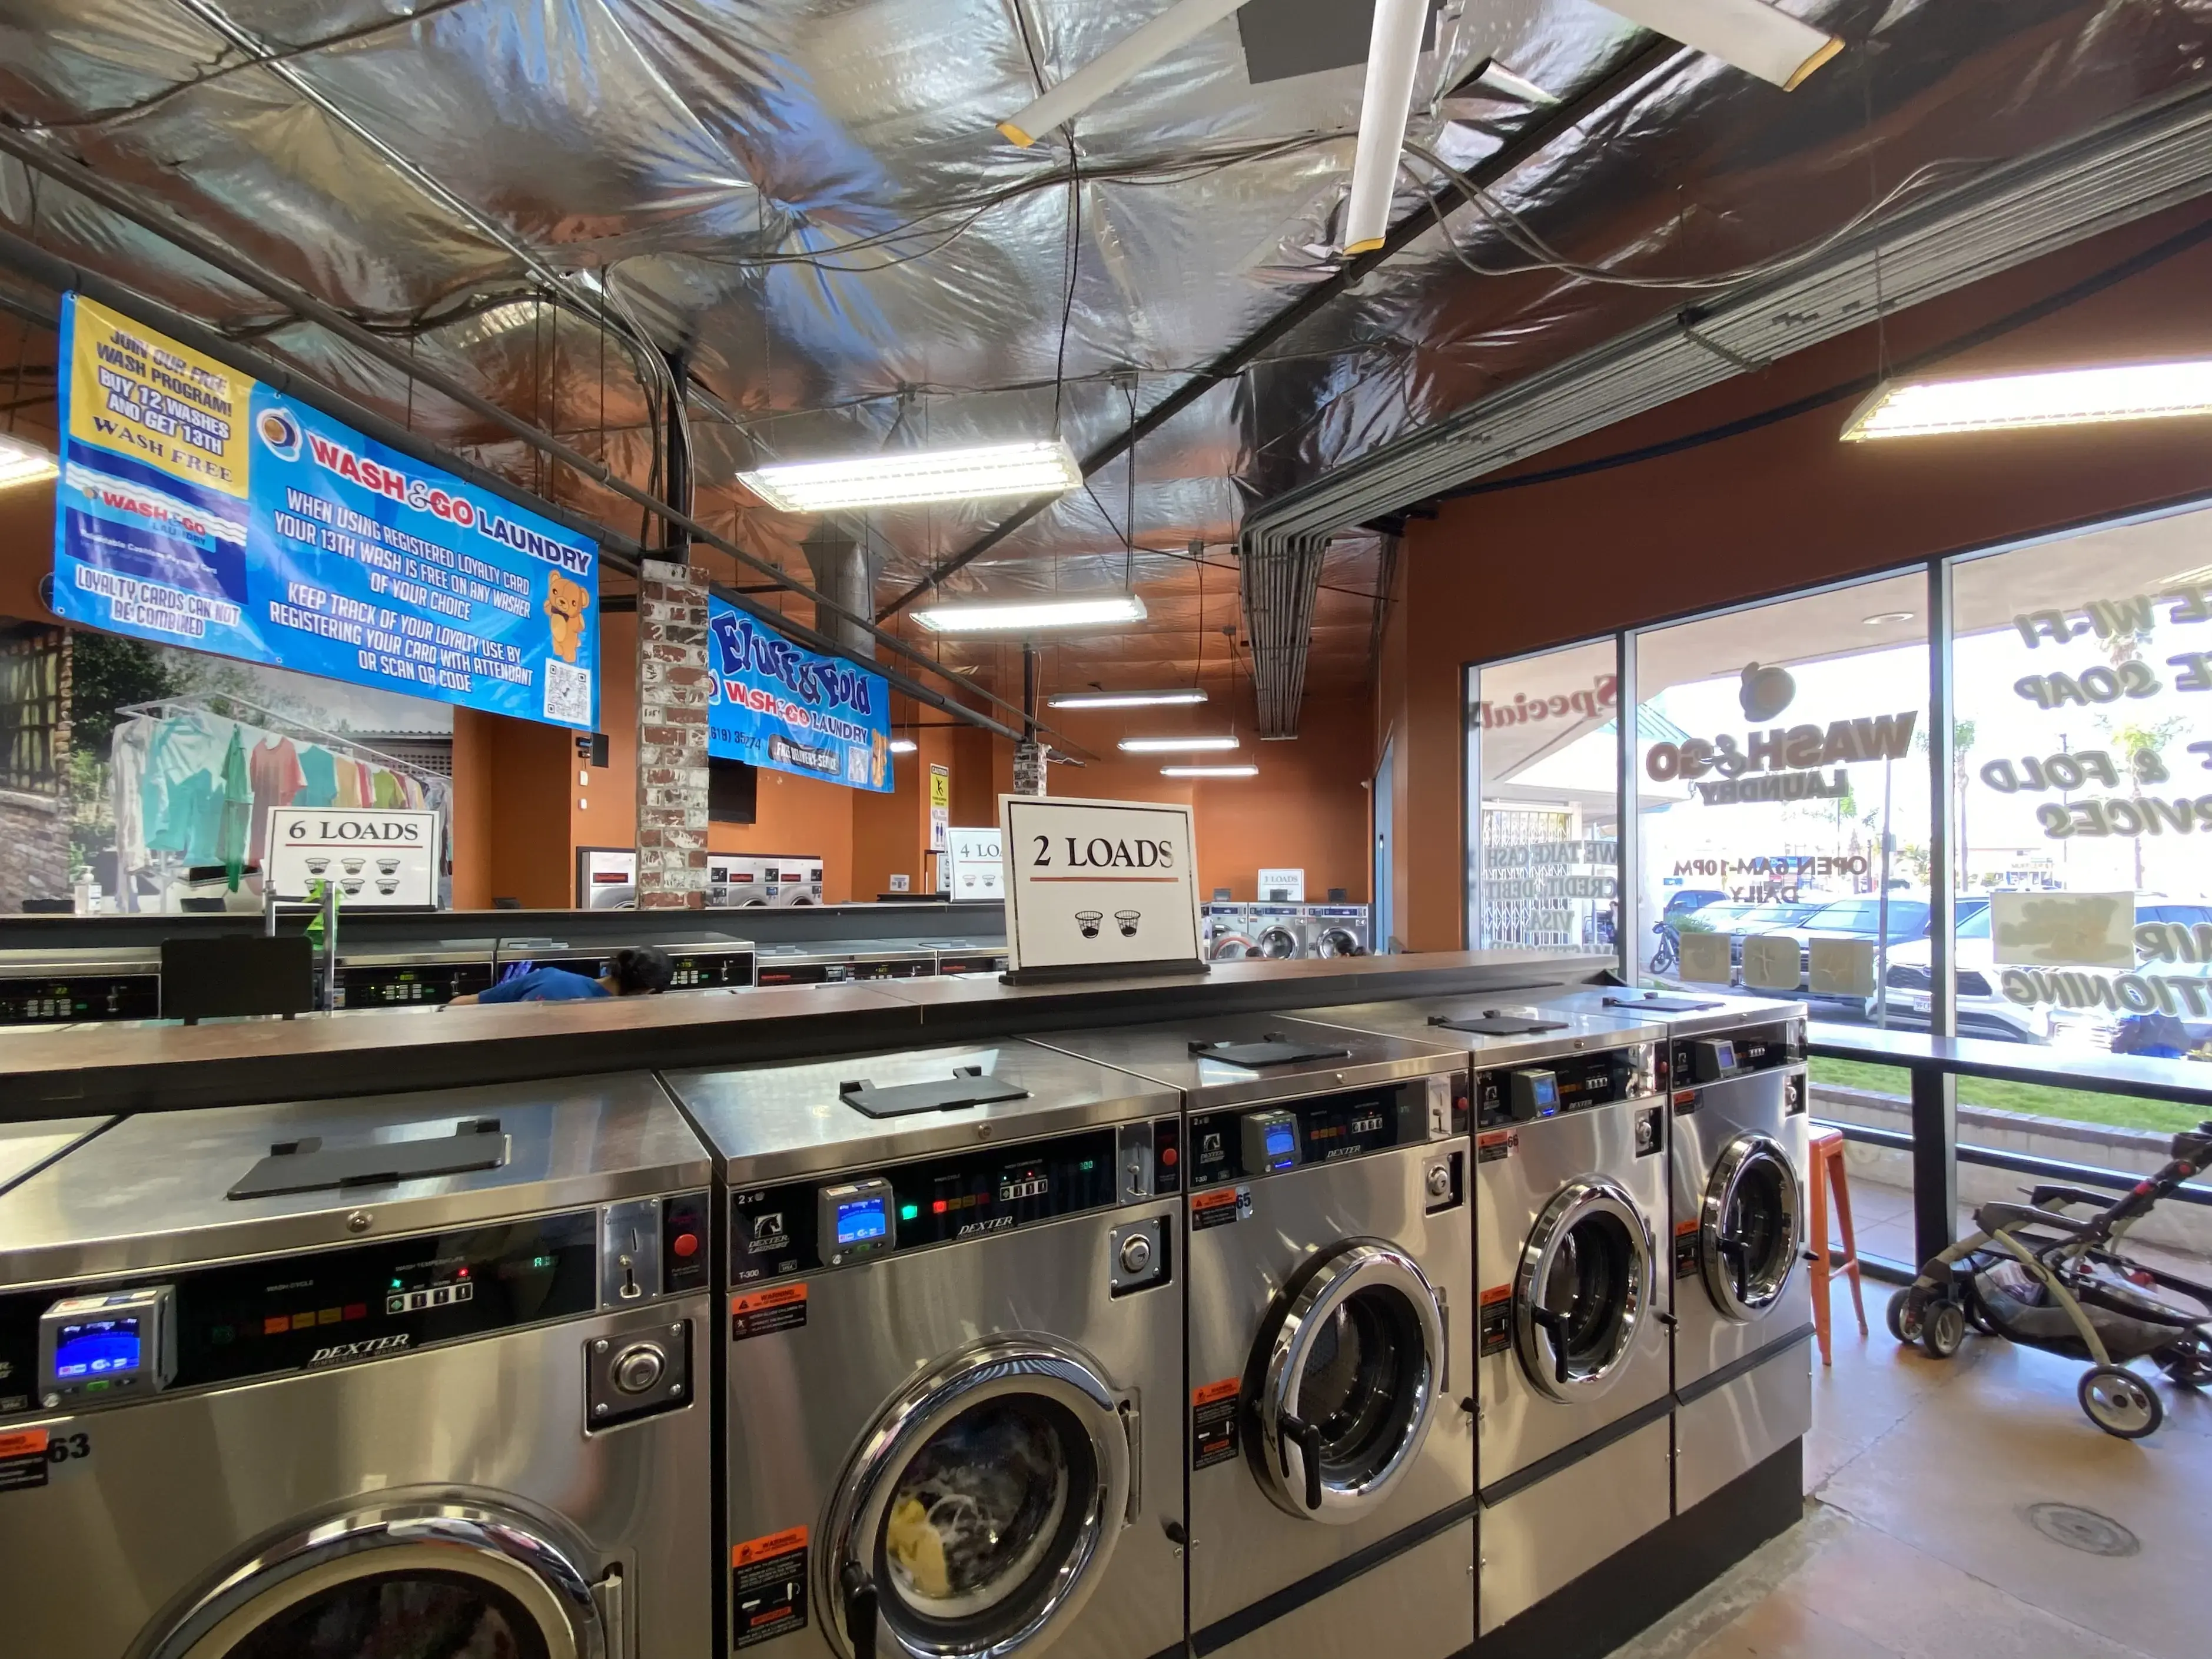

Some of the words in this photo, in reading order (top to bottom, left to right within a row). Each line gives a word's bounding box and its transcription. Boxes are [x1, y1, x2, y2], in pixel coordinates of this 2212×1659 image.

[97, 341, 145, 377] WASH
[151, 367, 232, 417] PROGRAM!
[110, 330, 148, 359] JOIN
[153, 349, 186, 376] OUR
[190, 367, 227, 395] FREE
[98, 365, 136, 399] BUY
[138, 385, 162, 412] 12
[164, 396, 230, 440] WASHES
[107, 389, 141, 423] AND
[144, 410, 177, 437] GET
[182, 424, 223, 457] 13TH
[93, 416, 164, 457] WASH
[171, 449, 232, 482] FREE
[152, 522, 205, 545] LAUDRY
[287, 487, 333, 524] WHEN
[337, 507, 381, 541] USING
[384, 526, 454, 569] REGISTERED
[457, 553, 500, 585] LOYALTY
[503, 571, 530, 596] CARD
[478, 510, 590, 573] LAUNDRY
[274, 510, 316, 546] YOUR
[321, 529, 356, 558] 13TH
[360, 541, 402, 573] WASH
[405, 557, 418, 579] IS
[421, 562, 449, 589] FREE
[451, 574, 468, 595] ON
[470, 580, 490, 605] ANY
[492, 589, 531, 619] WASHER
[78, 566, 135, 601] LOYALTY
[141, 585, 184, 610] CARDS
[189, 596, 211, 618] CAN
[216, 603, 240, 625] NOT
[370, 572, 389, 593] OF
[393, 579, 428, 606] YOUR
[430, 592, 471, 621] CHOICE
[115, 600, 134, 620] BE
[137, 605, 204, 636] COMBINED
[288, 582, 327, 610] KEEP
[331, 593, 377, 625] TRACK
[380, 608, 398, 630] OF
[401, 614, 433, 642] YOUR
[436, 625, 480, 654] LOYALTY
[481, 639, 504, 660] USE
[507, 645, 522, 664] BY
[270, 600, 361, 646] REGISTERING
[366, 628, 402, 656] YOUR
[405, 640, 437, 665] CARD
[441, 648, 471, 672] WITH
[473, 656, 533, 687] ATTENDANT
[358, 650, 379, 671] OR
[381, 656, 415, 681] SCAN
[418, 665, 436, 685] QR
[439, 669, 472, 693] CODE
[711, 610, 803, 692] Fluff
[798, 662, 821, 704] &
[813, 662, 871, 716] Fold
[812, 712, 868, 744] LAUNDRY
[290, 821, 305, 838] 6
[320, 821, 419, 841] LOADS
[961, 843, 969, 857] 4
[1034, 835, 1051, 867] 2
[1065, 837, 1174, 868] LOADS
[1271, 875, 1298, 883] LOADS
[1327, 1145, 1361, 1157] DEXTER
[738, 1195, 745, 1204] 2
[1236, 1193, 1251, 1209] 65
[749, 1235, 788, 1247] DEXTER
[959, 1216, 1013, 1235] DEXTER
[739, 1269, 759, 1279] T-300
[310, 1333, 410, 1361] DEXTER
[48, 1433, 91, 1464] 63
